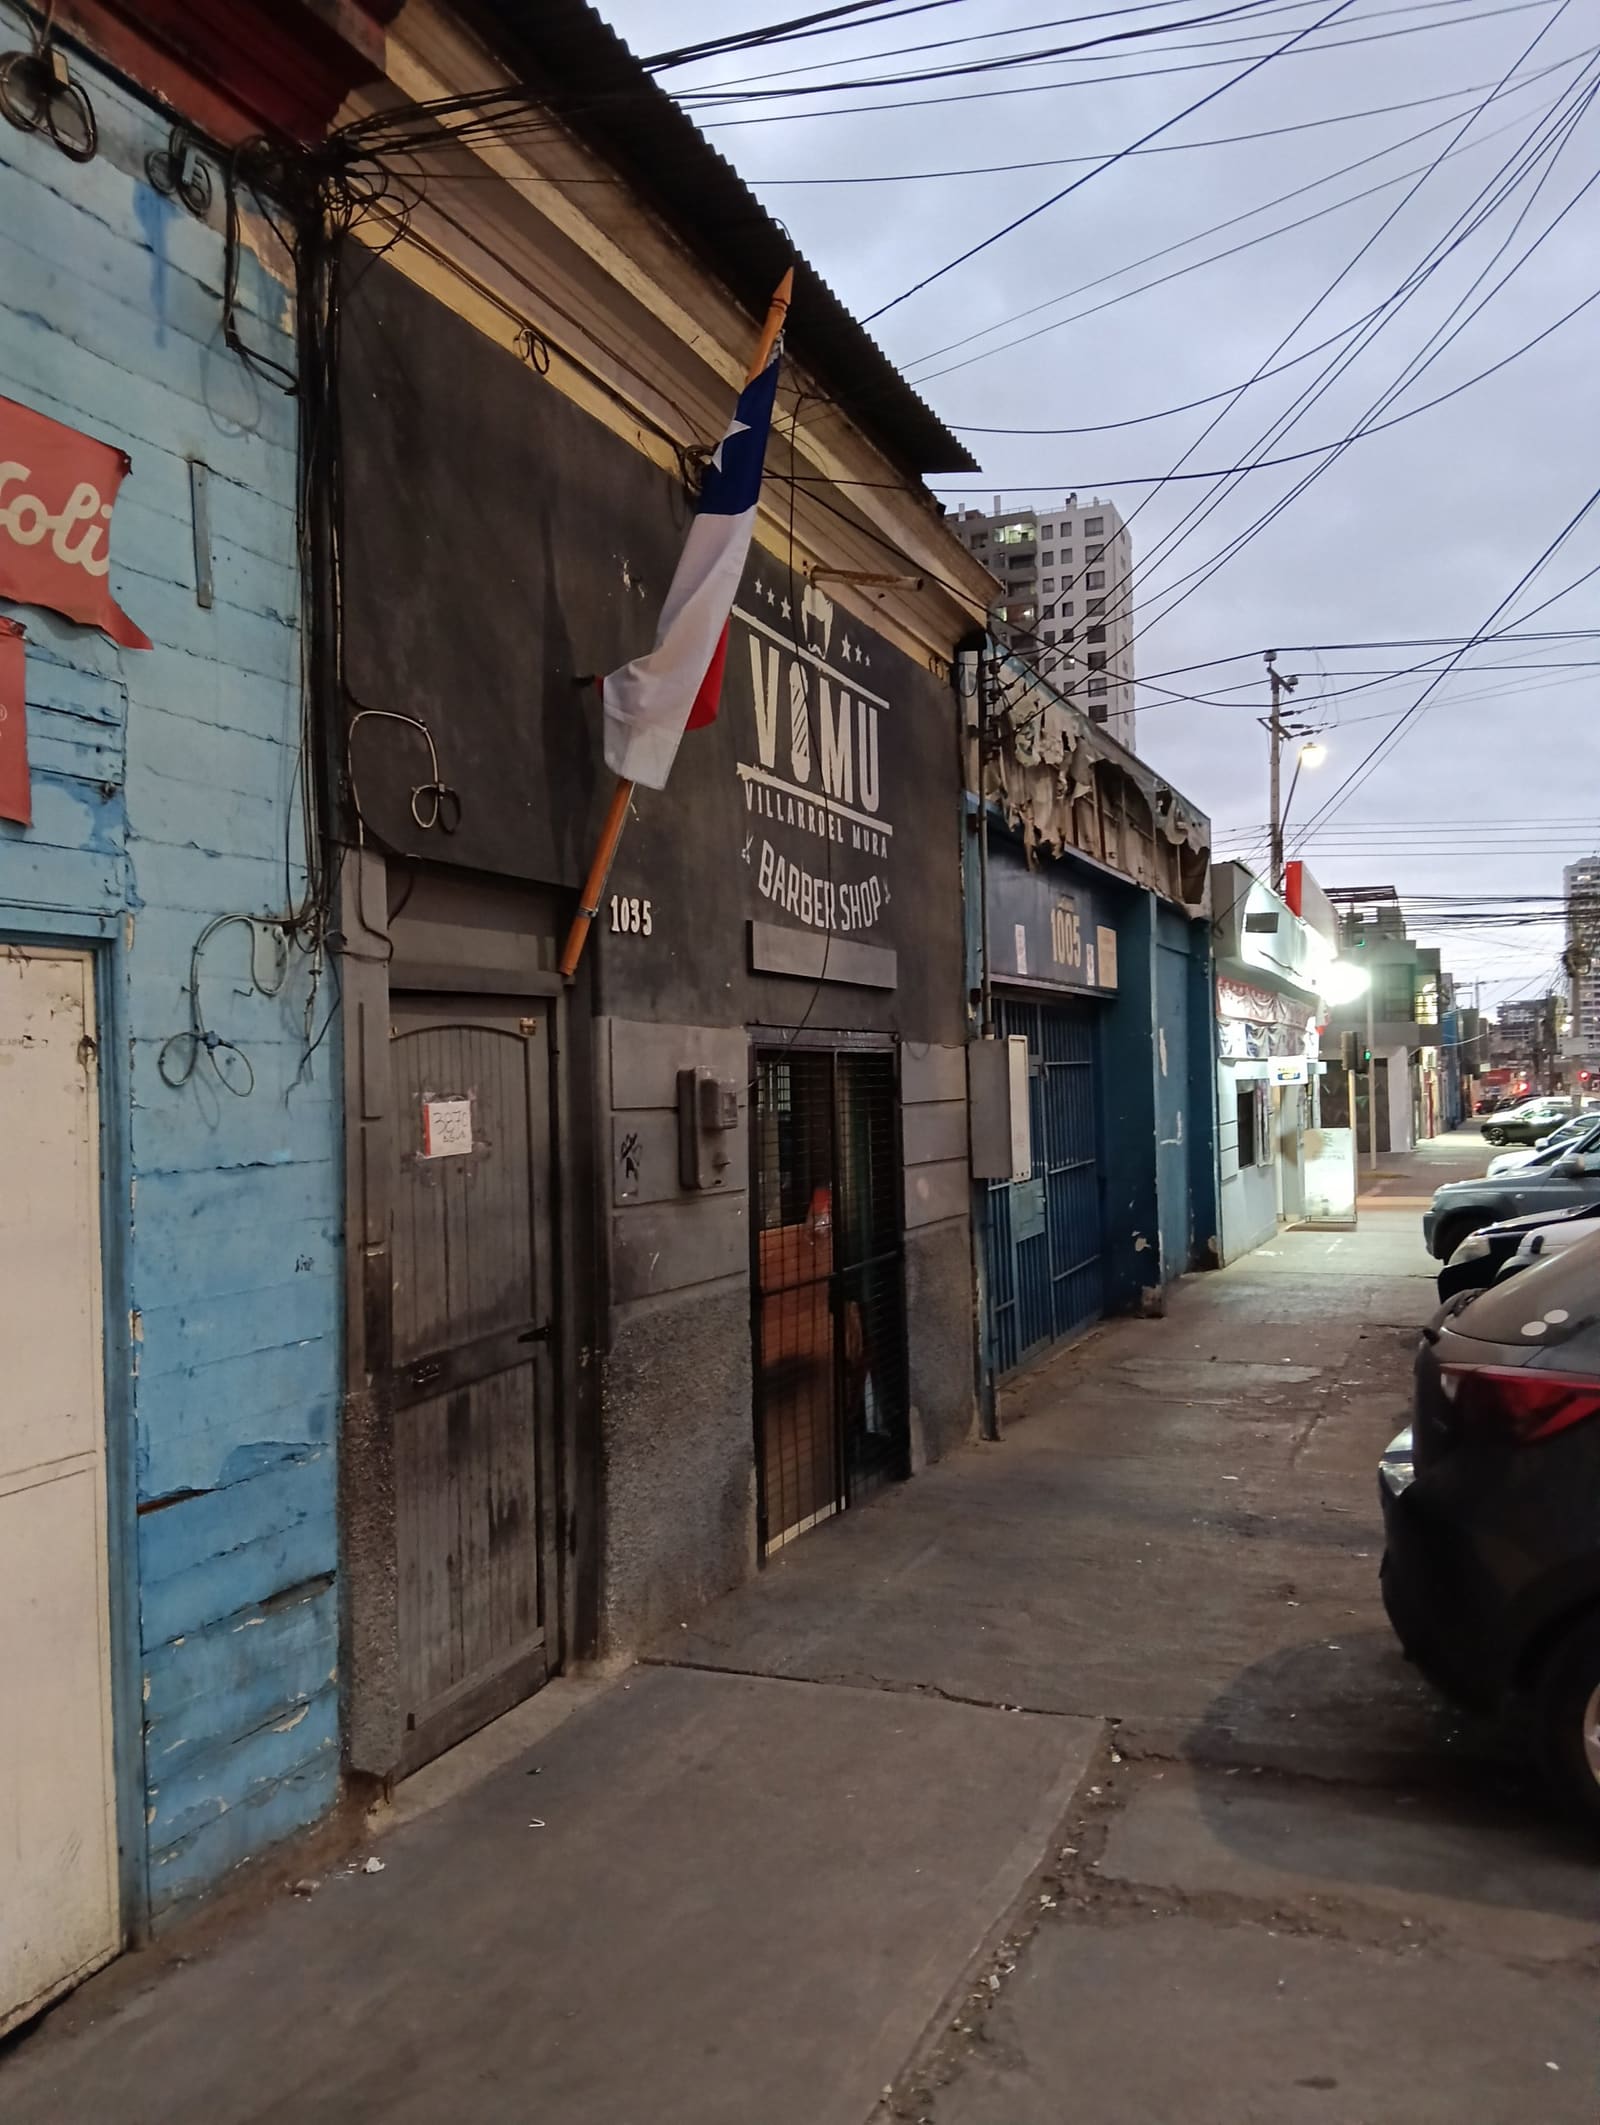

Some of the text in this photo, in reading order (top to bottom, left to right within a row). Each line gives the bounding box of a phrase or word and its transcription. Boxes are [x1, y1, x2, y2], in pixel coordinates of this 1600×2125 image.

[745, 781, 888, 859] VILLARROEL MURA
[611, 895, 652, 935] 1035
[758, 840, 881, 931] BARBER SHOP
[1050, 908, 1081, 968] 1005
